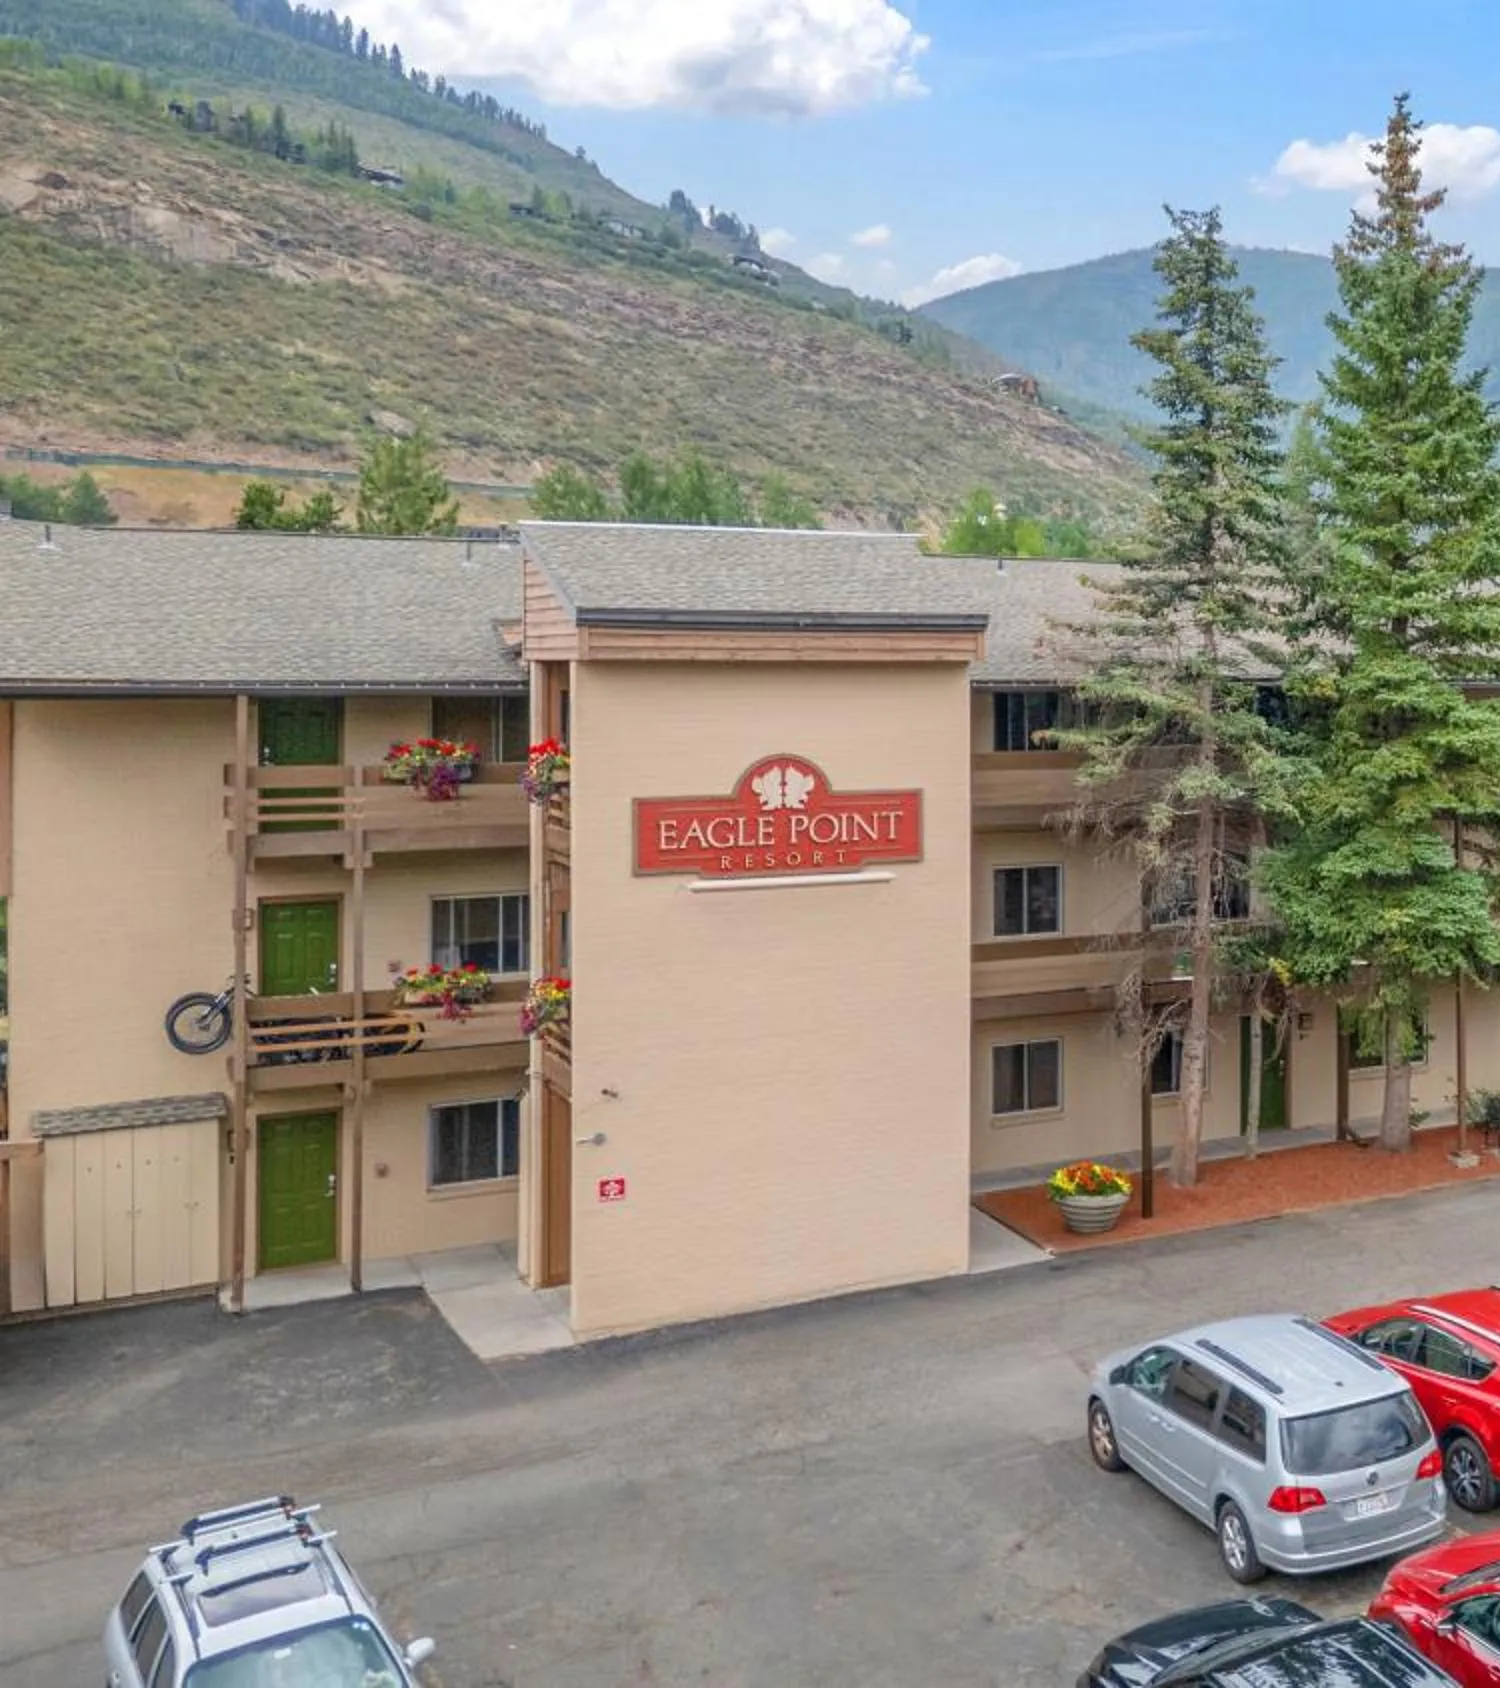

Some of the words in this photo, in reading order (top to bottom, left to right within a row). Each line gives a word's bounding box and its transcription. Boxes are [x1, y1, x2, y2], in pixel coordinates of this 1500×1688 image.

[658, 815, 776, 850] EAGLE
[790, 811, 904, 845] POINT
[720, 850, 847, 869] RESORT
